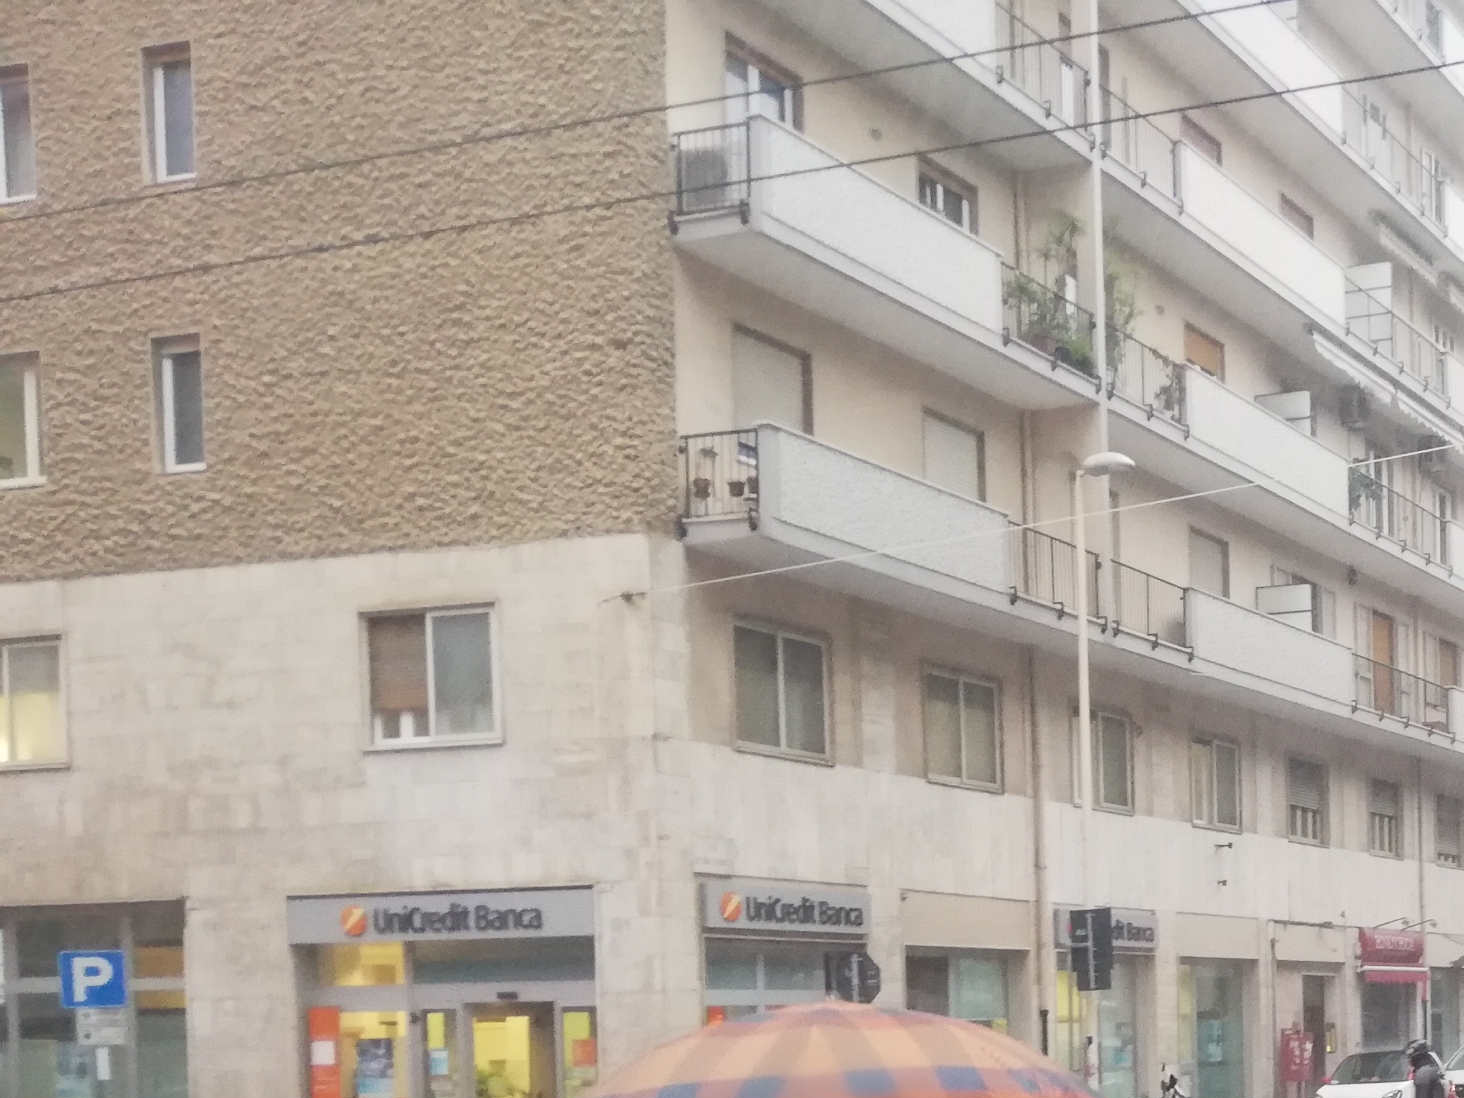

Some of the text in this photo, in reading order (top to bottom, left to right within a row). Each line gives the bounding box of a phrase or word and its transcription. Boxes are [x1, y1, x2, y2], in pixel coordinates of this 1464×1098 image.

[373, 902, 543, 934] UniCredit Banca
[745, 895, 864, 927] UniCredit Banca
[1126, 922, 1155, 942] Banca
[71, 956, 114, 1003] P
